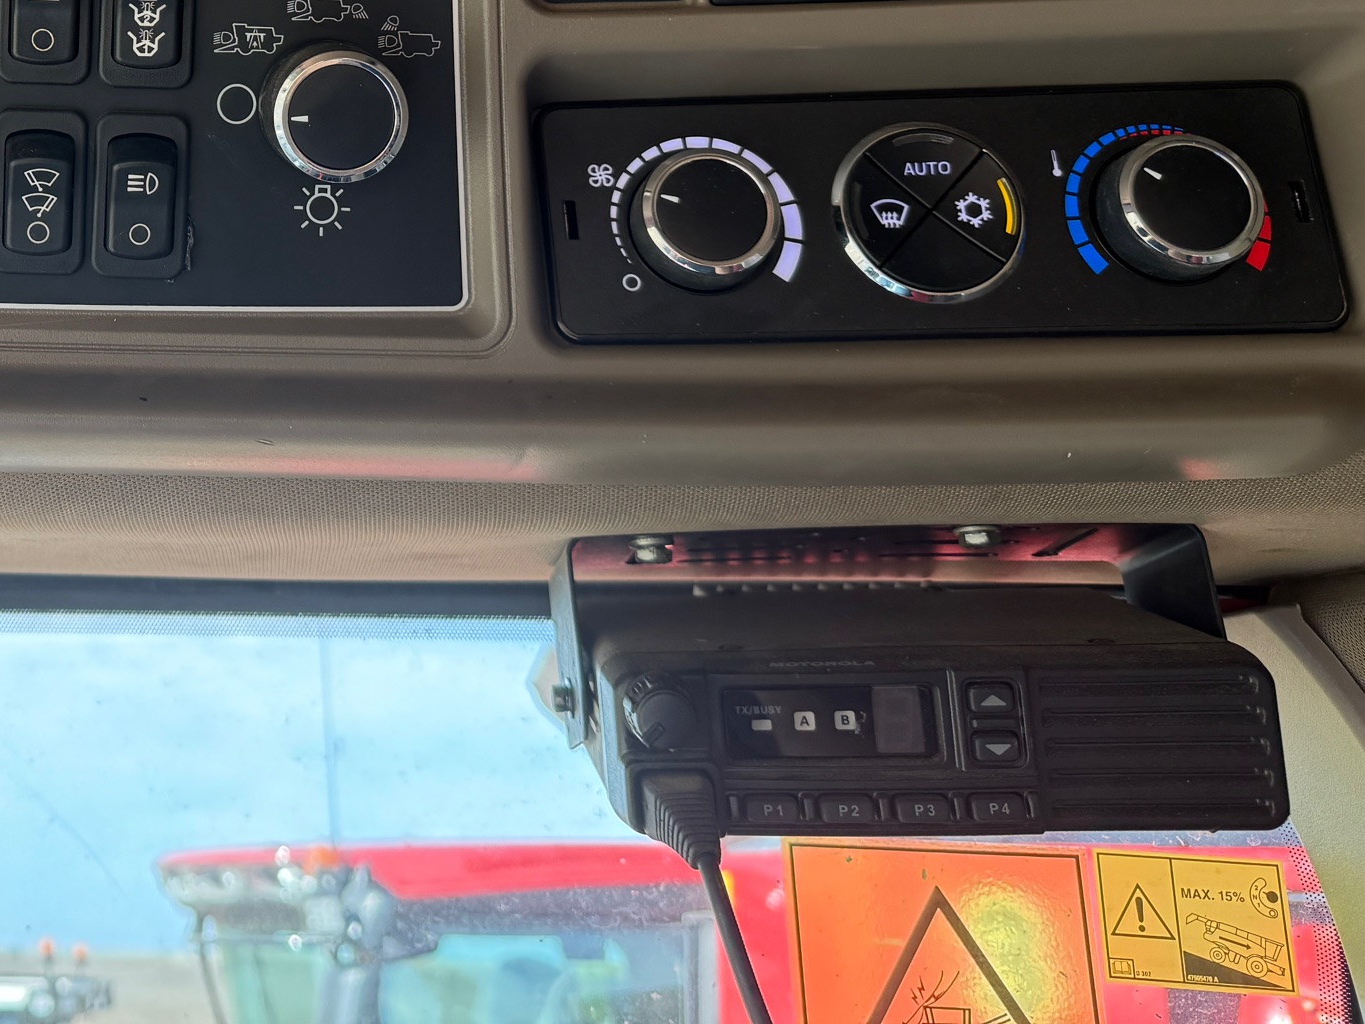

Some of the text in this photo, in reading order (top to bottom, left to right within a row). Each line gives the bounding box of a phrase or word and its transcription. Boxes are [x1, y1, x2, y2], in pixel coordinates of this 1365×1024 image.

[904, 161, 951, 176] AUTO
[735, 705, 782, 715] TX/BUSY
[800, 715, 810, 726] A
[840, 714, 850, 726] B
[763, 804, 784, 816] P1
[838, 804, 860, 817] P2
[914, 804, 936, 816] P3
[989, 802, 1011, 815] P4
[1180, 887, 1246, 903] MAX. 15%
